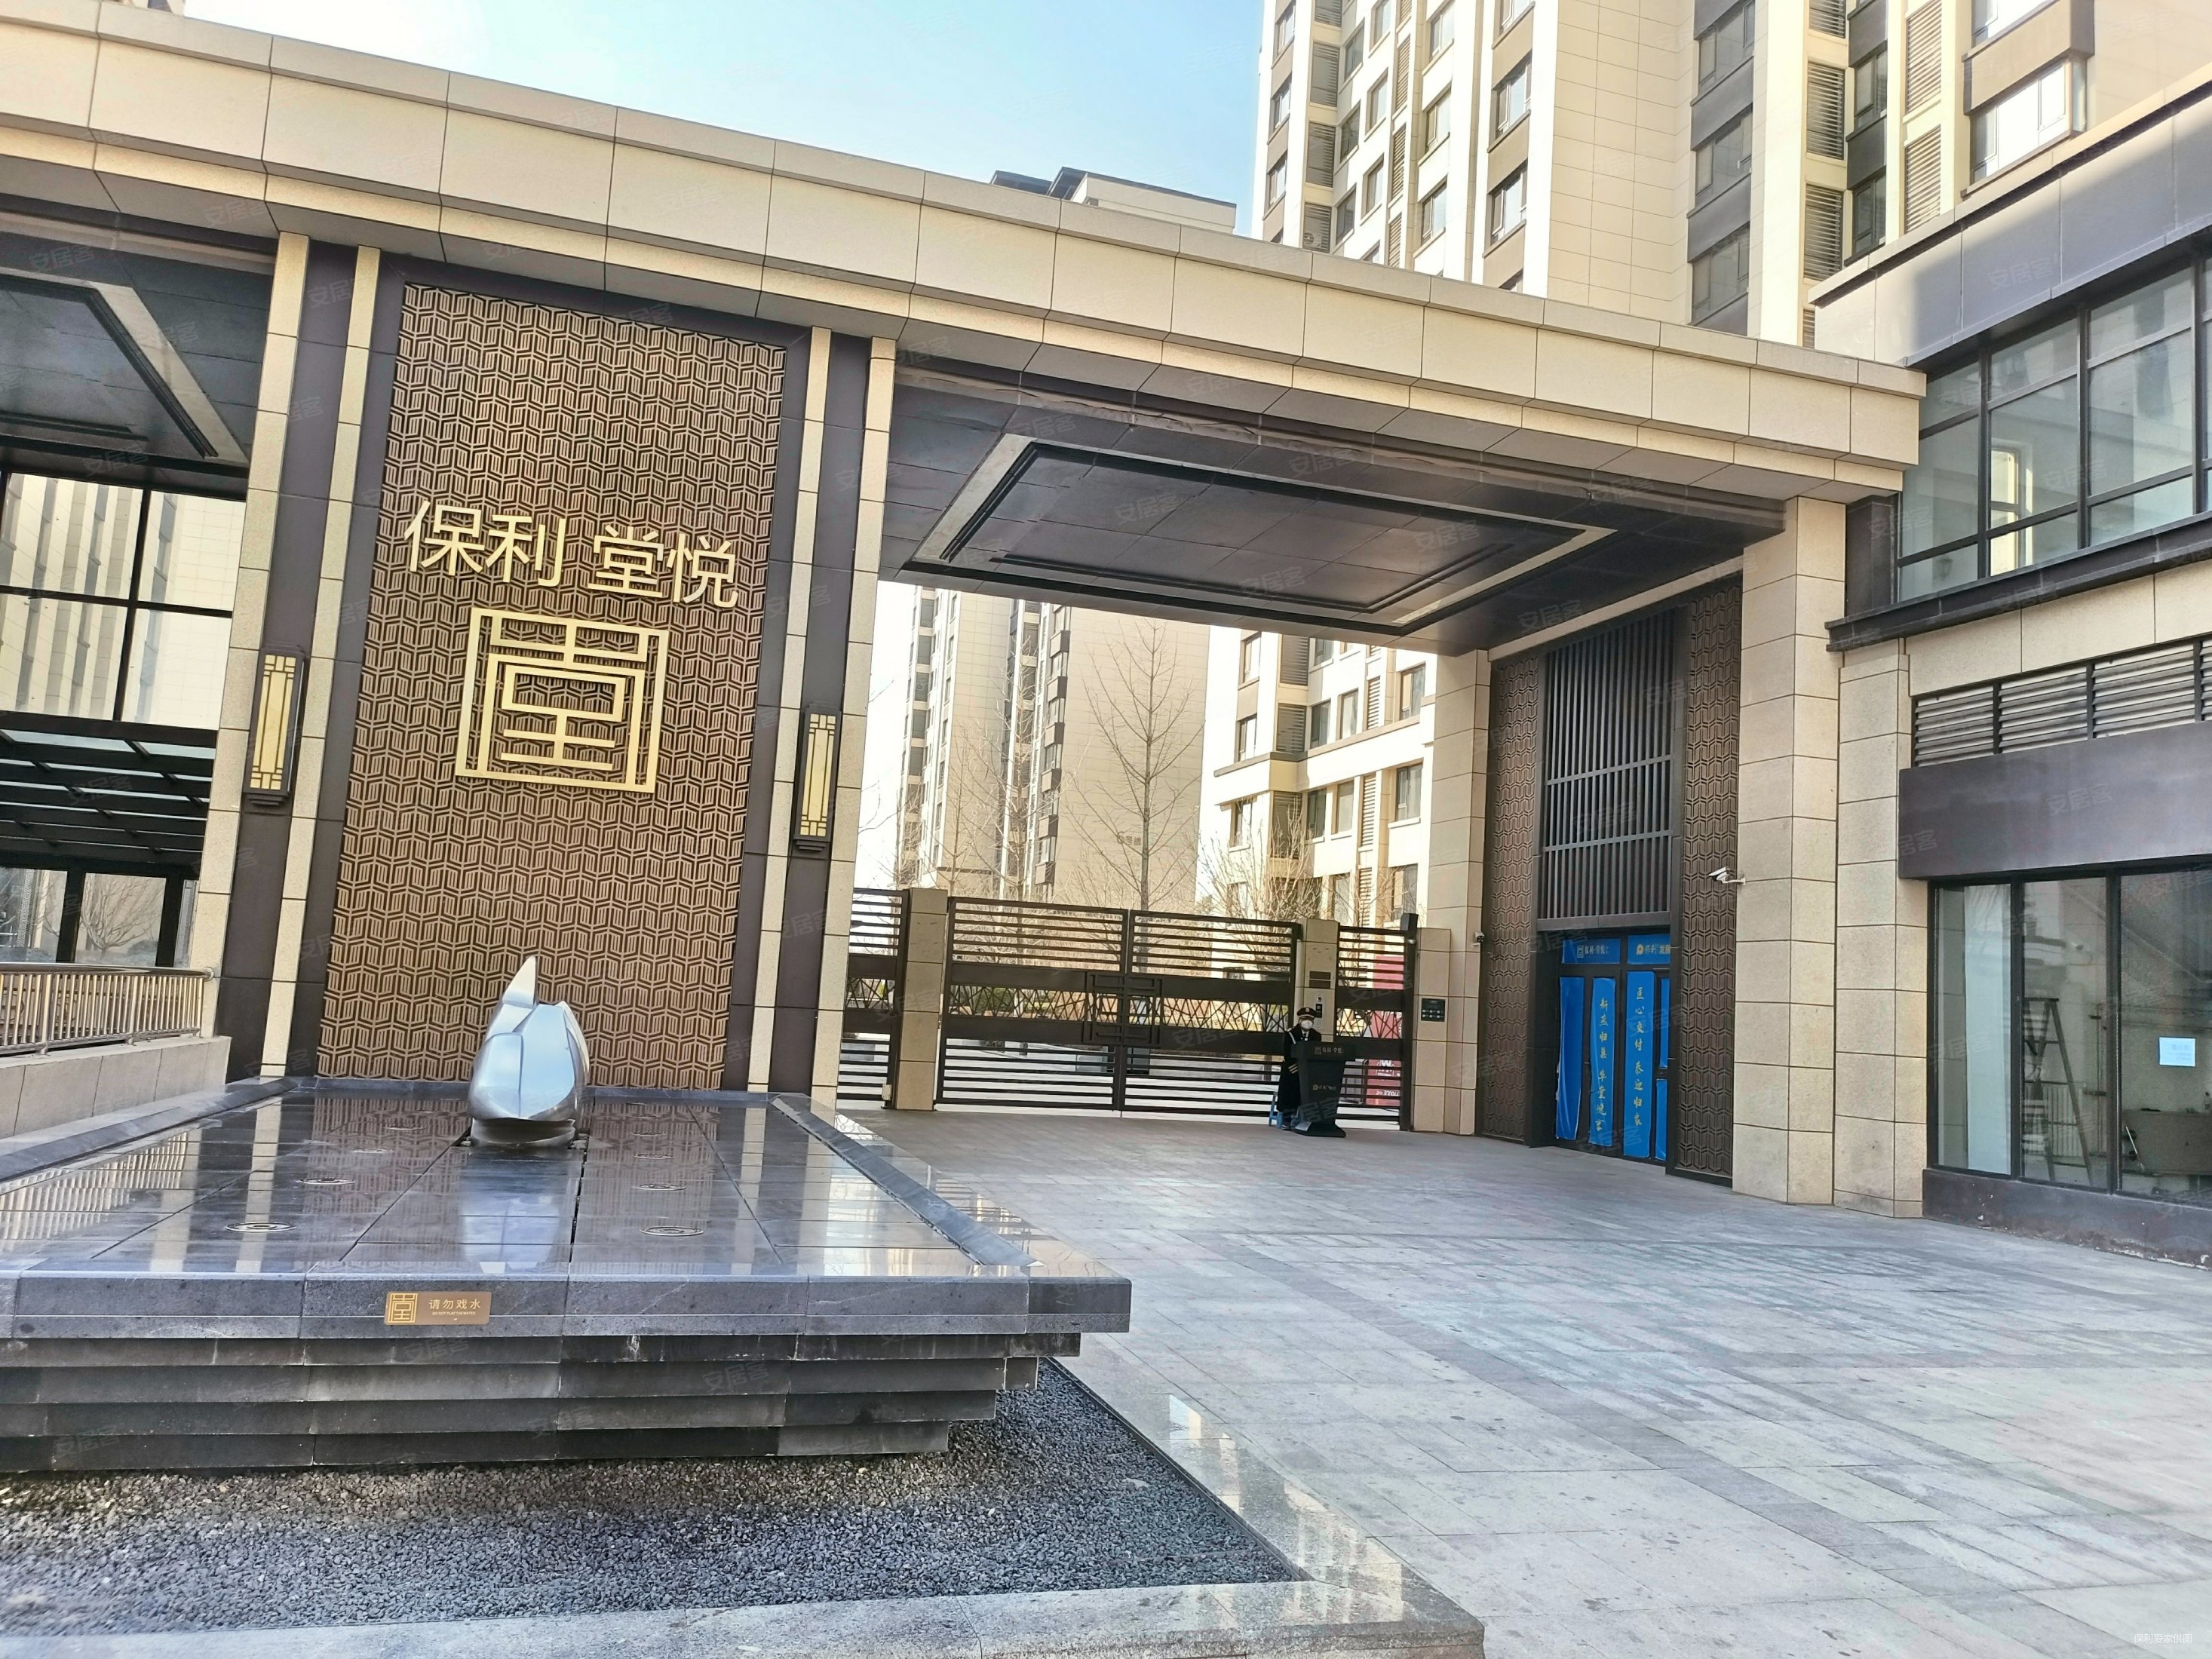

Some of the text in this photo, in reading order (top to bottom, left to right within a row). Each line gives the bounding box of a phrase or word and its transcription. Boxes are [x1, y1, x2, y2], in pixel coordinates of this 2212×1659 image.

[403, 500, 740, 609] 保利 堂悦
[428, 1299, 481, 1310] 请勿戏水
